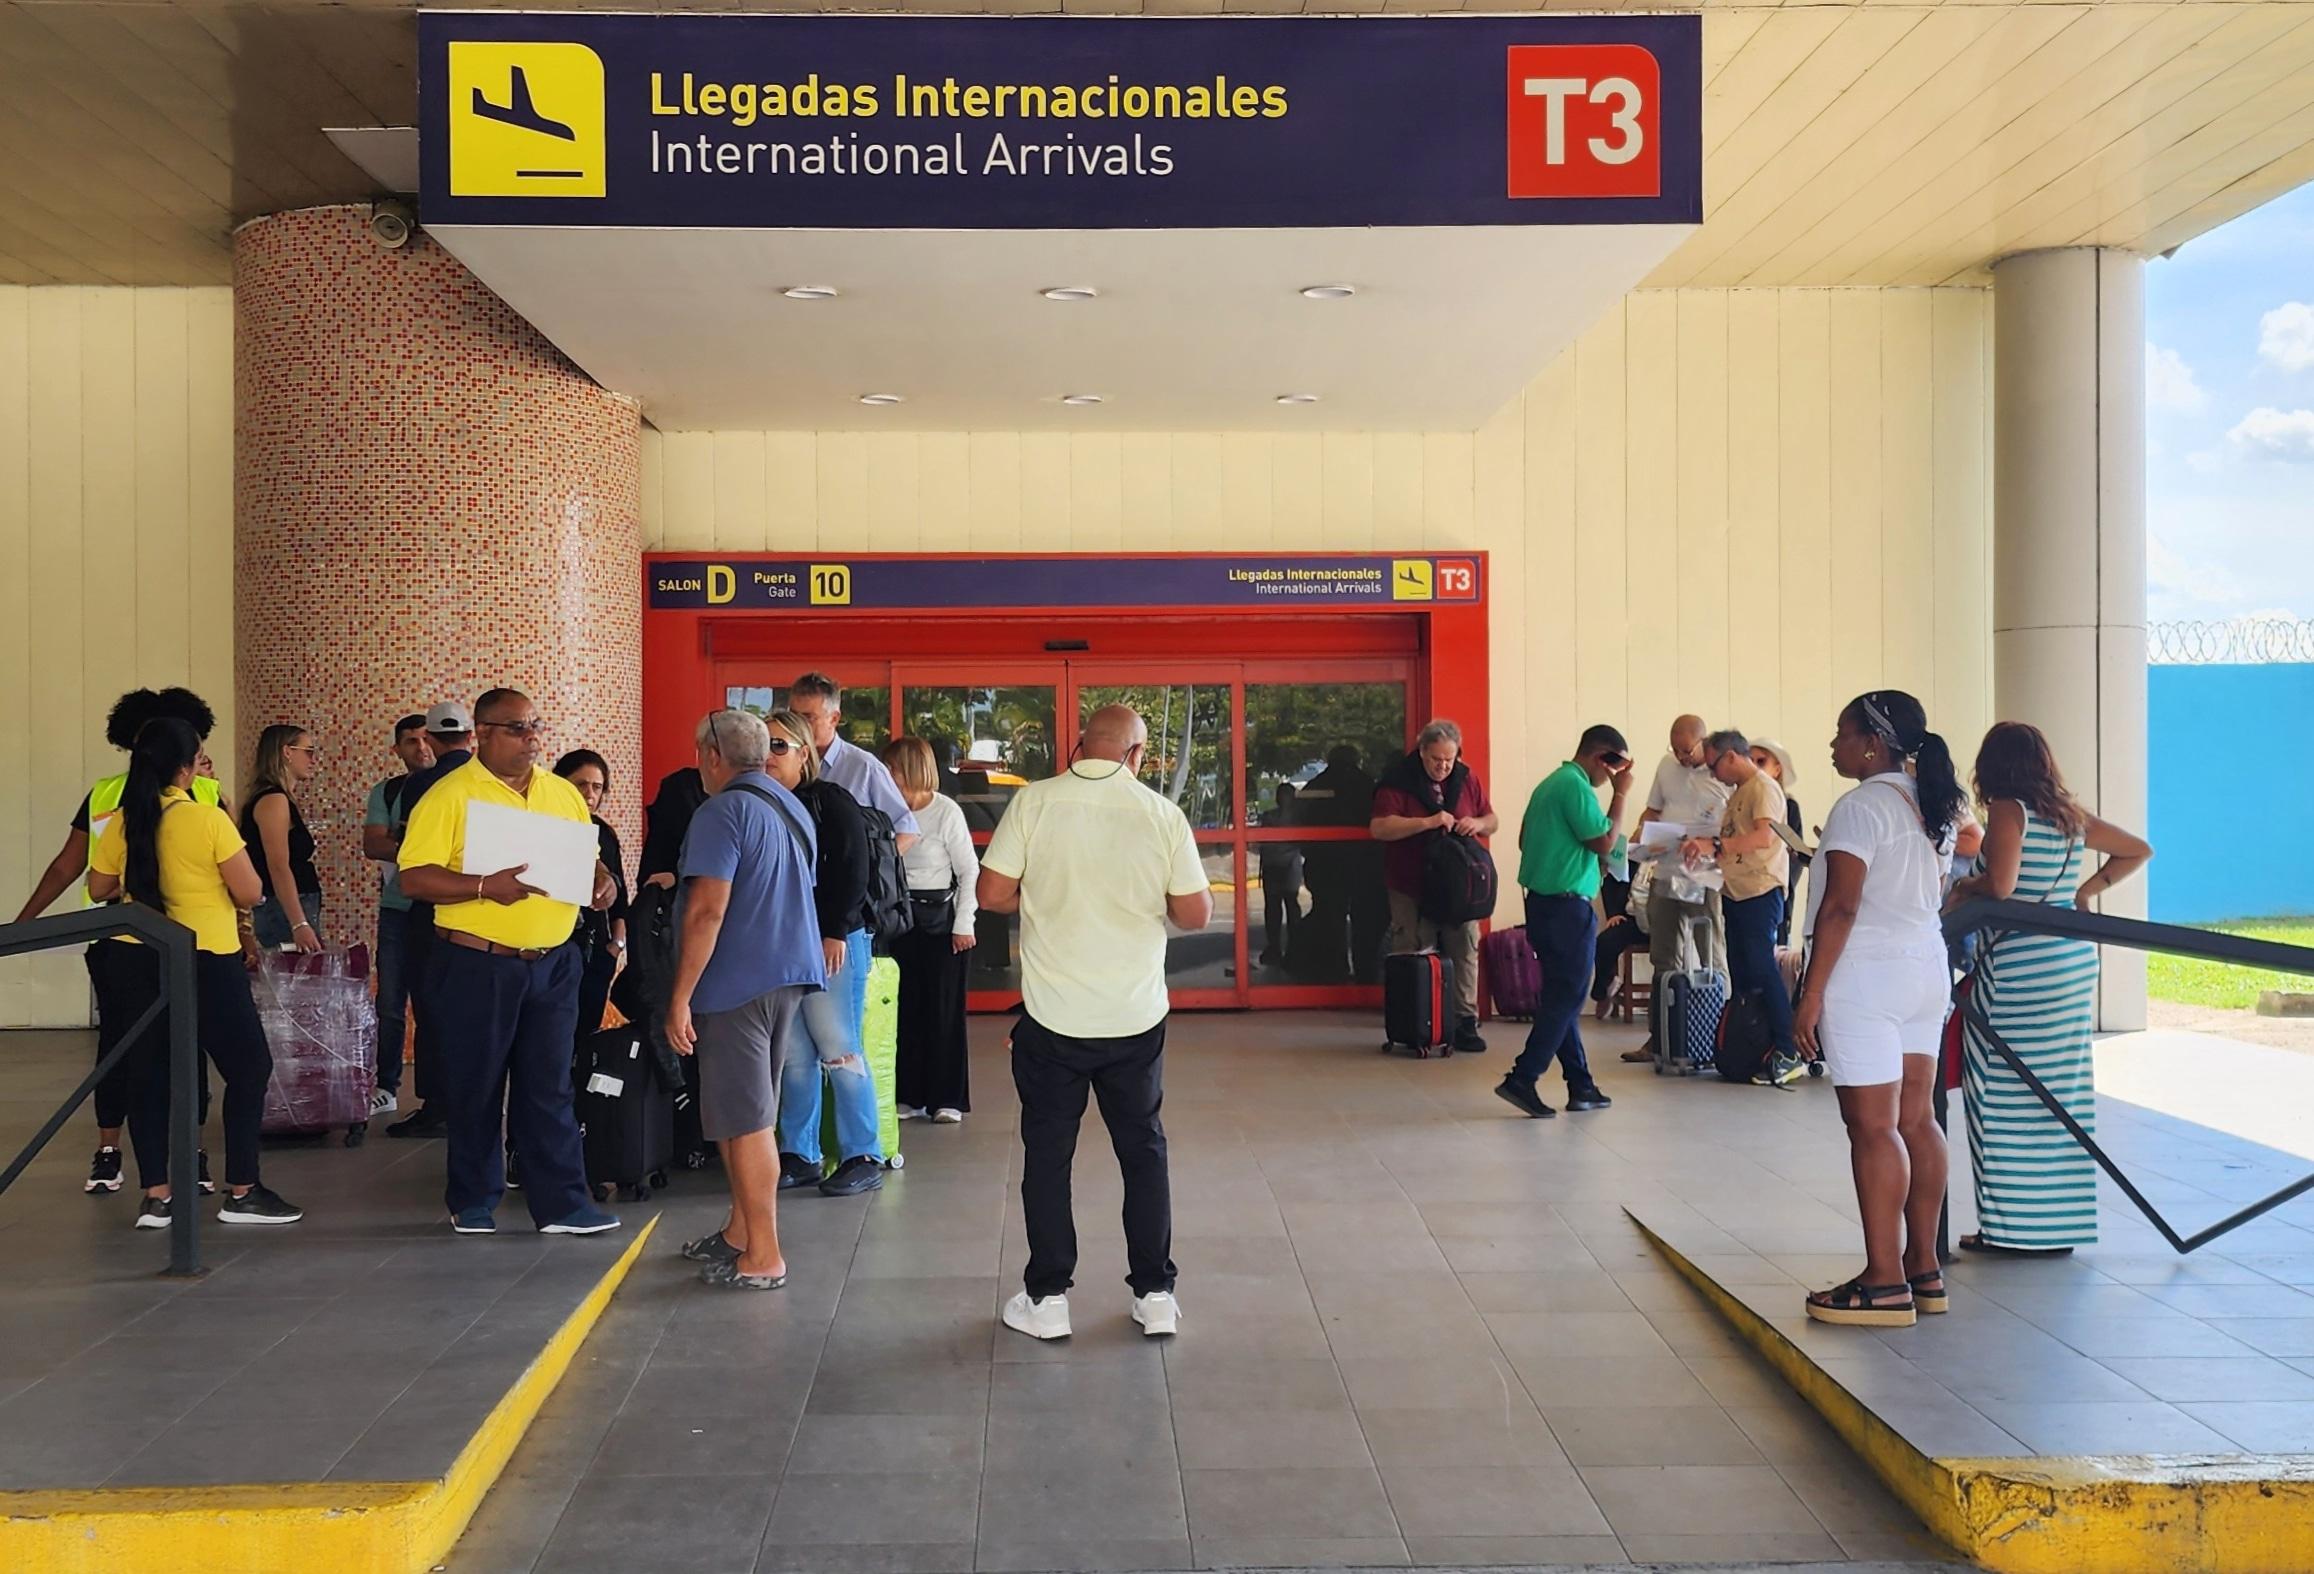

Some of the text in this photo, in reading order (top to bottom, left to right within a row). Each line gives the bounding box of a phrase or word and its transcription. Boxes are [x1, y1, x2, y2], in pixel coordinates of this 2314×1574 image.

[651, 72, 1288, 120] Llegadas Internacionales
[1524, 77, 1644, 165] T3
[652, 133, 1174, 175] International Arrivals
[658, 564, 736, 604] SALON D
[754, 572, 796, 584] Puerta
[815, 571, 844, 598] 10
[1229, 568, 1382, 583] Llegadas Internacionales
[1441, 568, 1471, 591] T3
[768, 586, 796, 598] Gate
[1256, 582, 1382, 595] International Arrivals
